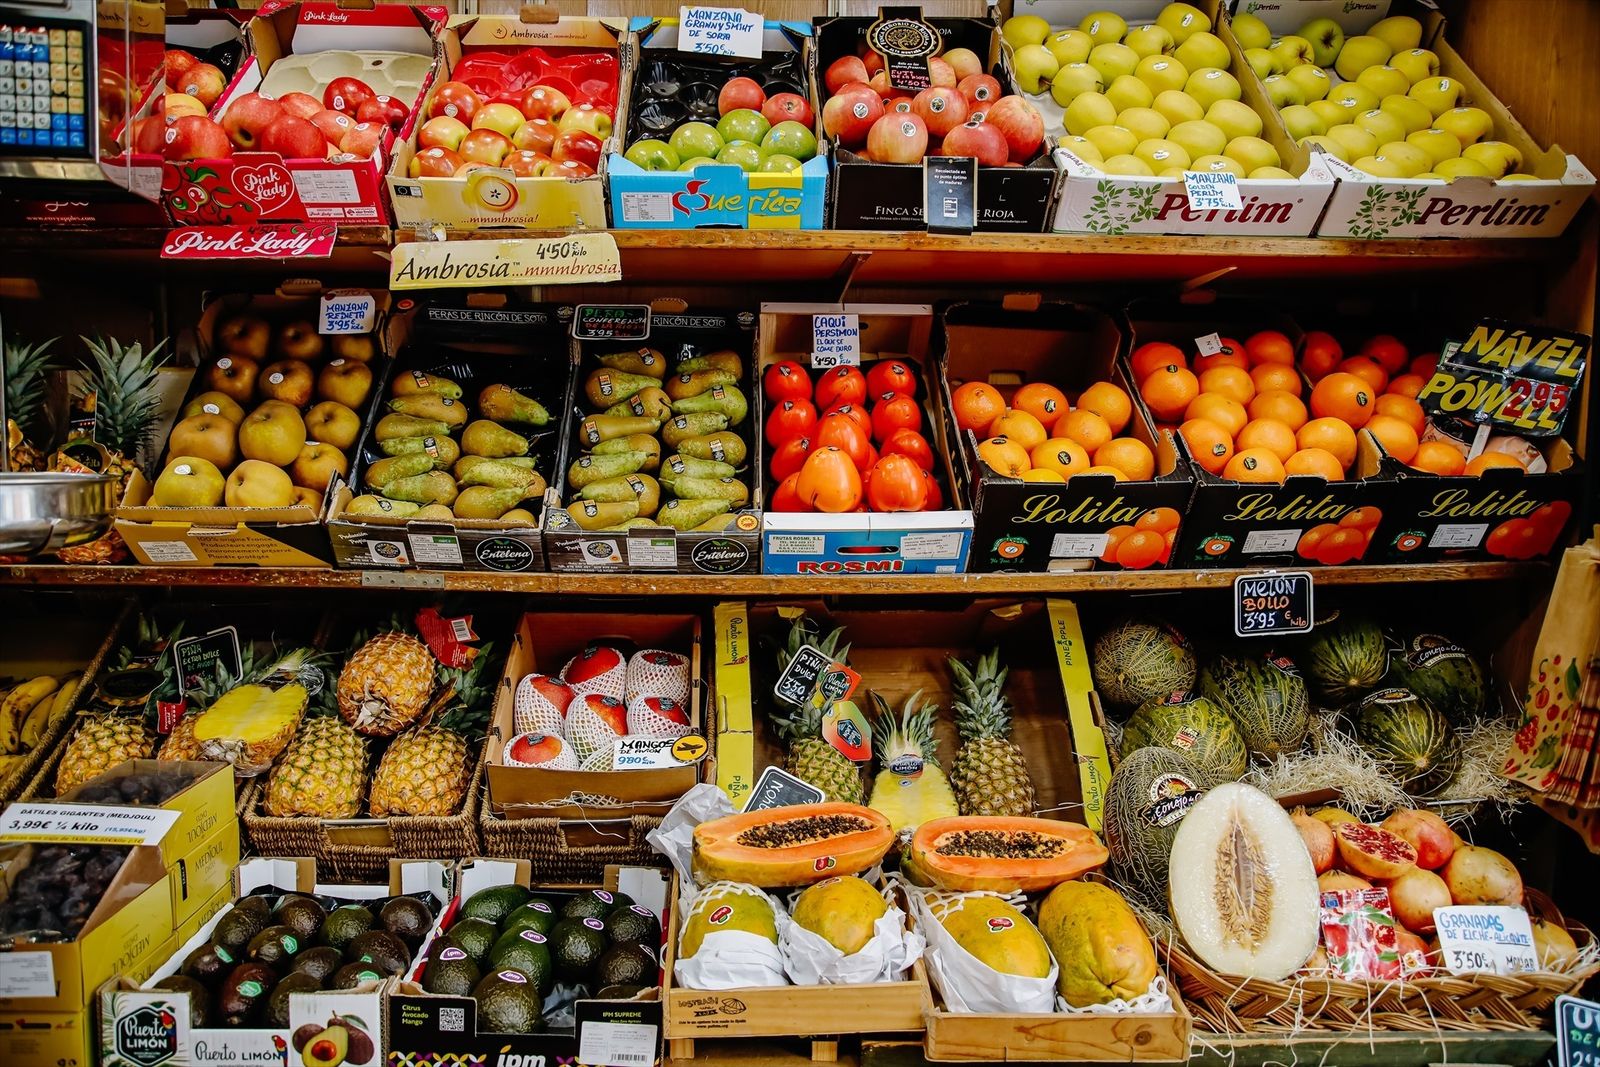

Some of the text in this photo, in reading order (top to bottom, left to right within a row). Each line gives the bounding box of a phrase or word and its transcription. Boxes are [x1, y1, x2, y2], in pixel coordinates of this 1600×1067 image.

[304, 11, 349, 22] Pink Lady
[687, 10, 743, 23] MANZANA
[685, 19, 723, 31] GRANNY
[510, 27, 549, 39] Ambrosia
[689, 30, 700, 38] DE
[243, 168, 281, 193] Pink
[1184, 173, 1236, 184] MANZANA
[255, 181, 289, 202] Lady
[875, 205, 909, 216] FINCA
[983, 208, 1014, 218] RIOJA
[1416, 197, 1546, 226] Perlim
[165, 231, 318, 255] Pink Lady
[326, 301, 368, 312] MANZANA
[429, 310, 459, 320] PERAS
[460, 311, 473, 320] DE
[653, 316, 688, 326] RINCÓN
[689, 318, 701, 326] DE
[815, 328, 858, 337] PERSIMON
[1461, 326, 1584, 378] NÁVEL
[1011, 494, 1148, 524] Lolita
[1222, 493, 1354, 521] Lolita
[1417, 488, 1545, 518] Lolita
[798, 560, 904, 574] ROSMI
[1242, 596, 1290, 612] BOLLO
[1058, 619, 1073, 666] PINEAPPLE
[620, 739, 675, 750] MANGOS
[59, 810, 105, 818] GIGANTES
[9, 820, 53, 831] 3,99€
[71, 821, 99, 831] kilo
[187, 813, 219, 843] MEDJOUL
[194, 841, 224, 872] MEDJOUL
[1439, 911, 1504, 932] GRANADAS
[1446, 930, 1458, 939] DE
[402, 1012, 428, 1020] Avocado
[402, 1018, 423, 1027] Mango
[126, 1036, 168, 1049] LIMÓN
[195, 1041, 281, 1061] Puerto LIMÓN
